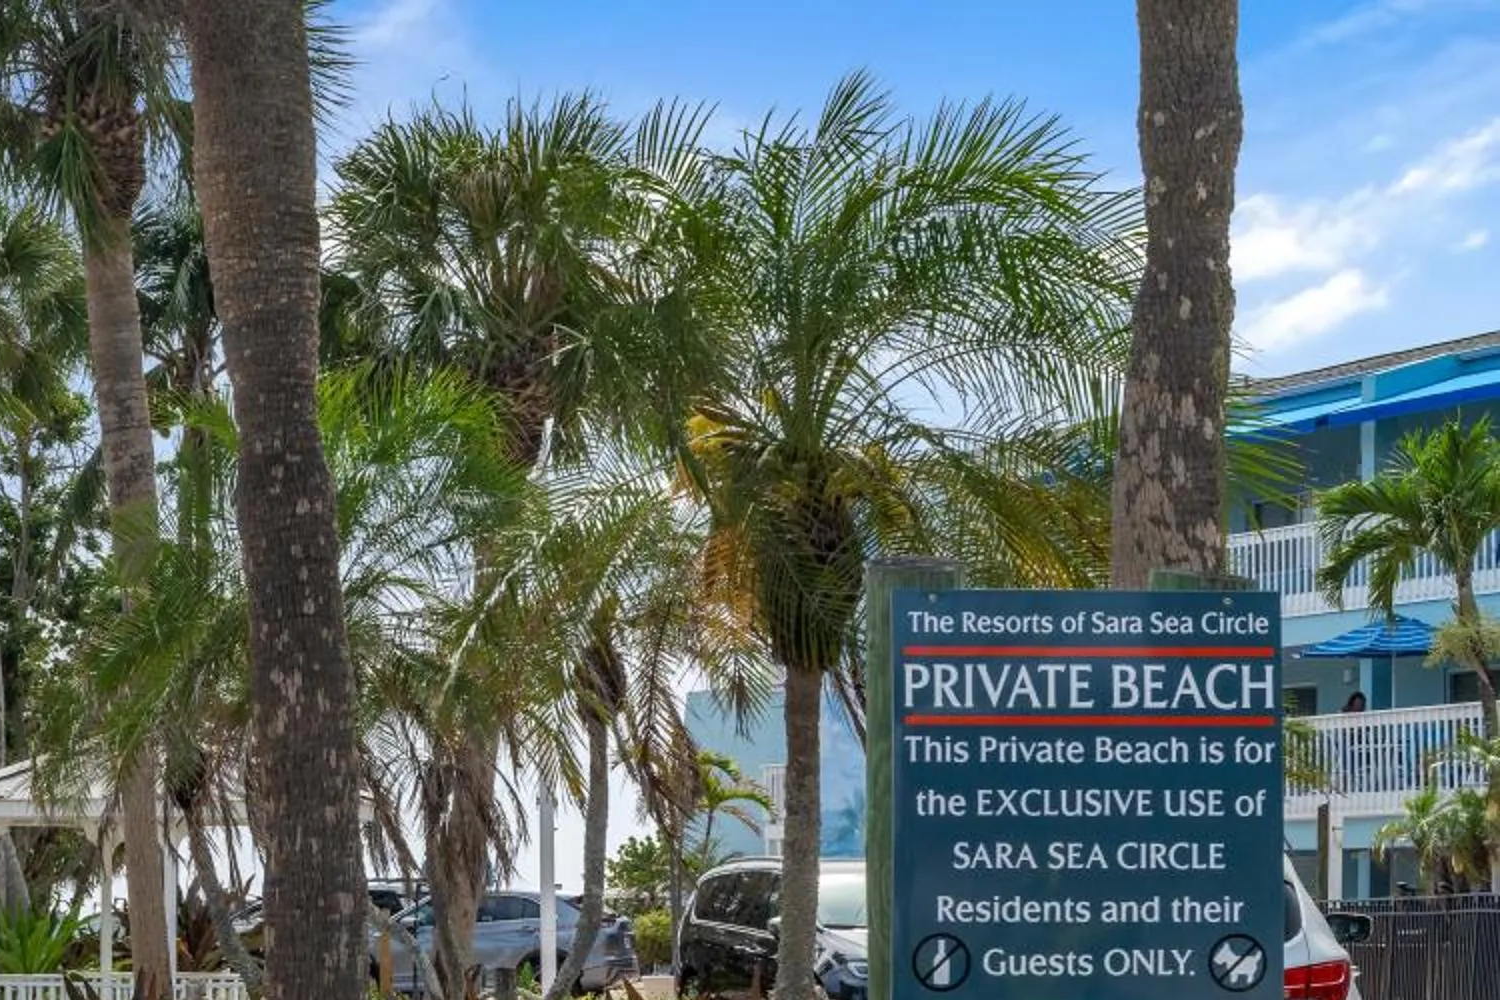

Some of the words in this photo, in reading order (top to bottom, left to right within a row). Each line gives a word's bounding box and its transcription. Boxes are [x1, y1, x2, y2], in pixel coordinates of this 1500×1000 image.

[907, 610, 955, 634] The
[961, 611, 1054, 635] Resorts
[1060, 611, 1087, 634] of
[1091, 611, 1144, 635] Sara
[1149, 611, 1194, 635] Sea
[1201, 611, 1269, 635] Circle
[903, 663, 1095, 709] PRIVATE
[1111, 663, 1275, 710] BEACH
[903, 735, 970, 763] This
[979, 735, 1085, 764] Private
[1095, 736, 1189, 764] Beach
[1200, 735, 1225, 765] is
[1234, 735, 1276, 764] for
[915, 788, 967, 817] the
[977, 788, 1153, 817] EXCLUSIVE
[1163, 789, 1225, 817] USE
[1234, 789, 1267, 817] of
[953, 841, 1039, 870] SARA
[1047, 841, 1109, 870] SEA
[1116, 841, 1226, 871] CIRCLE
[936, 895, 1092, 923] Residents
[1100, 895, 1160, 923] and
[1171, 895, 1244, 923] their
[982, 947, 1094, 977] Guests
[1103, 948, 1196, 977] ONLY.
